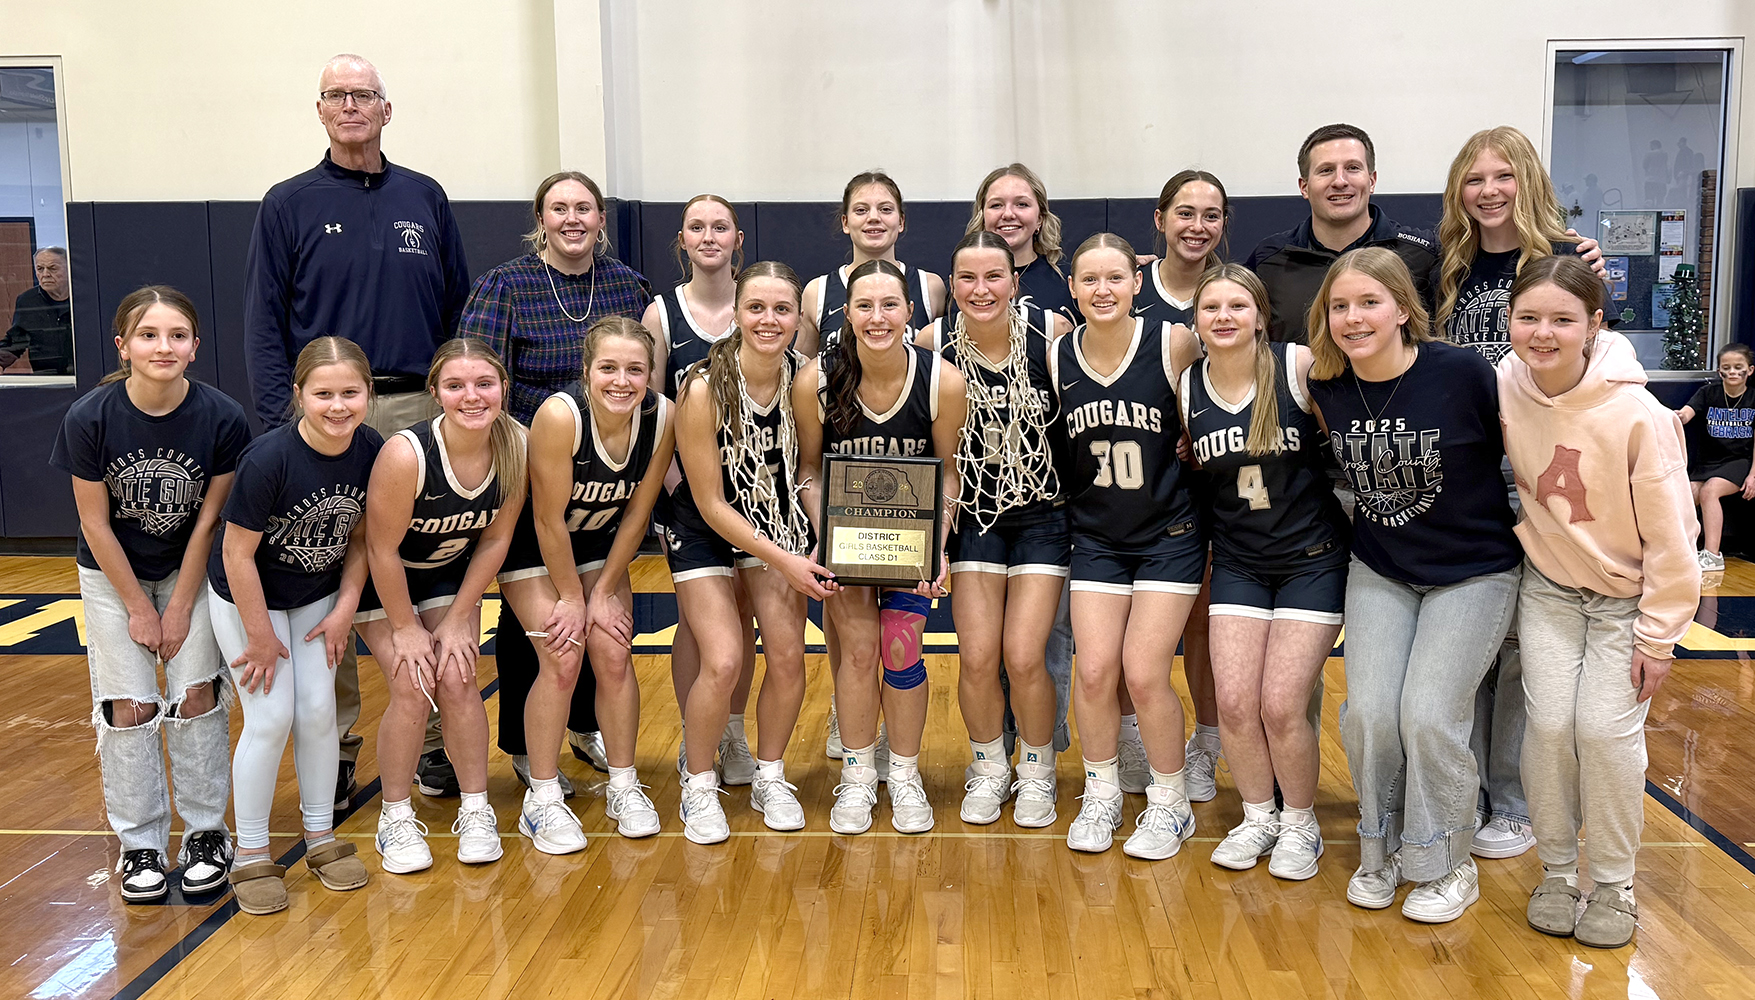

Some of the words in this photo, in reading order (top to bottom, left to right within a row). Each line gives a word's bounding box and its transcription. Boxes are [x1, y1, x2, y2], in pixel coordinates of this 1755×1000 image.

[393, 220, 425, 233] COUGARS
[1397, 232, 1431, 247] BOSHART
[1447, 307, 1492, 335] TATE
[1066, 399, 1162, 439] COUGARS
[1350, 418, 1406, 433] 2025
[831, 435, 927, 457] COUGARS
[1192, 425, 1300, 465] COUGS
[106, 448, 146, 476] CROSS
[157, 447, 205, 480] COUNTY
[1089, 440, 1145, 490] 30
[1330, 428, 1444, 493] STATE
[1343, 459, 1371, 473] ross
[1376, 448, 1442, 474] County
[160, 478, 205, 504] GIRL
[1236, 463, 1272, 511] 4
[286, 487, 327, 520] CROSS
[844, 506, 918, 519] CHAMPION
[1382, 493, 1436, 528] BASKETBALL
[408, 508, 500, 534] COUGA
[567, 506, 619, 533] 10
[268, 536, 345, 547] BASKETB
[838, 542, 865, 551] GIRLS
[866, 543, 919, 553] BASKETBALL
[858, 532, 901, 541] DISTRICT
[858, 553, 886, 561] CLASS
[887, 554, 898, 562] D1
